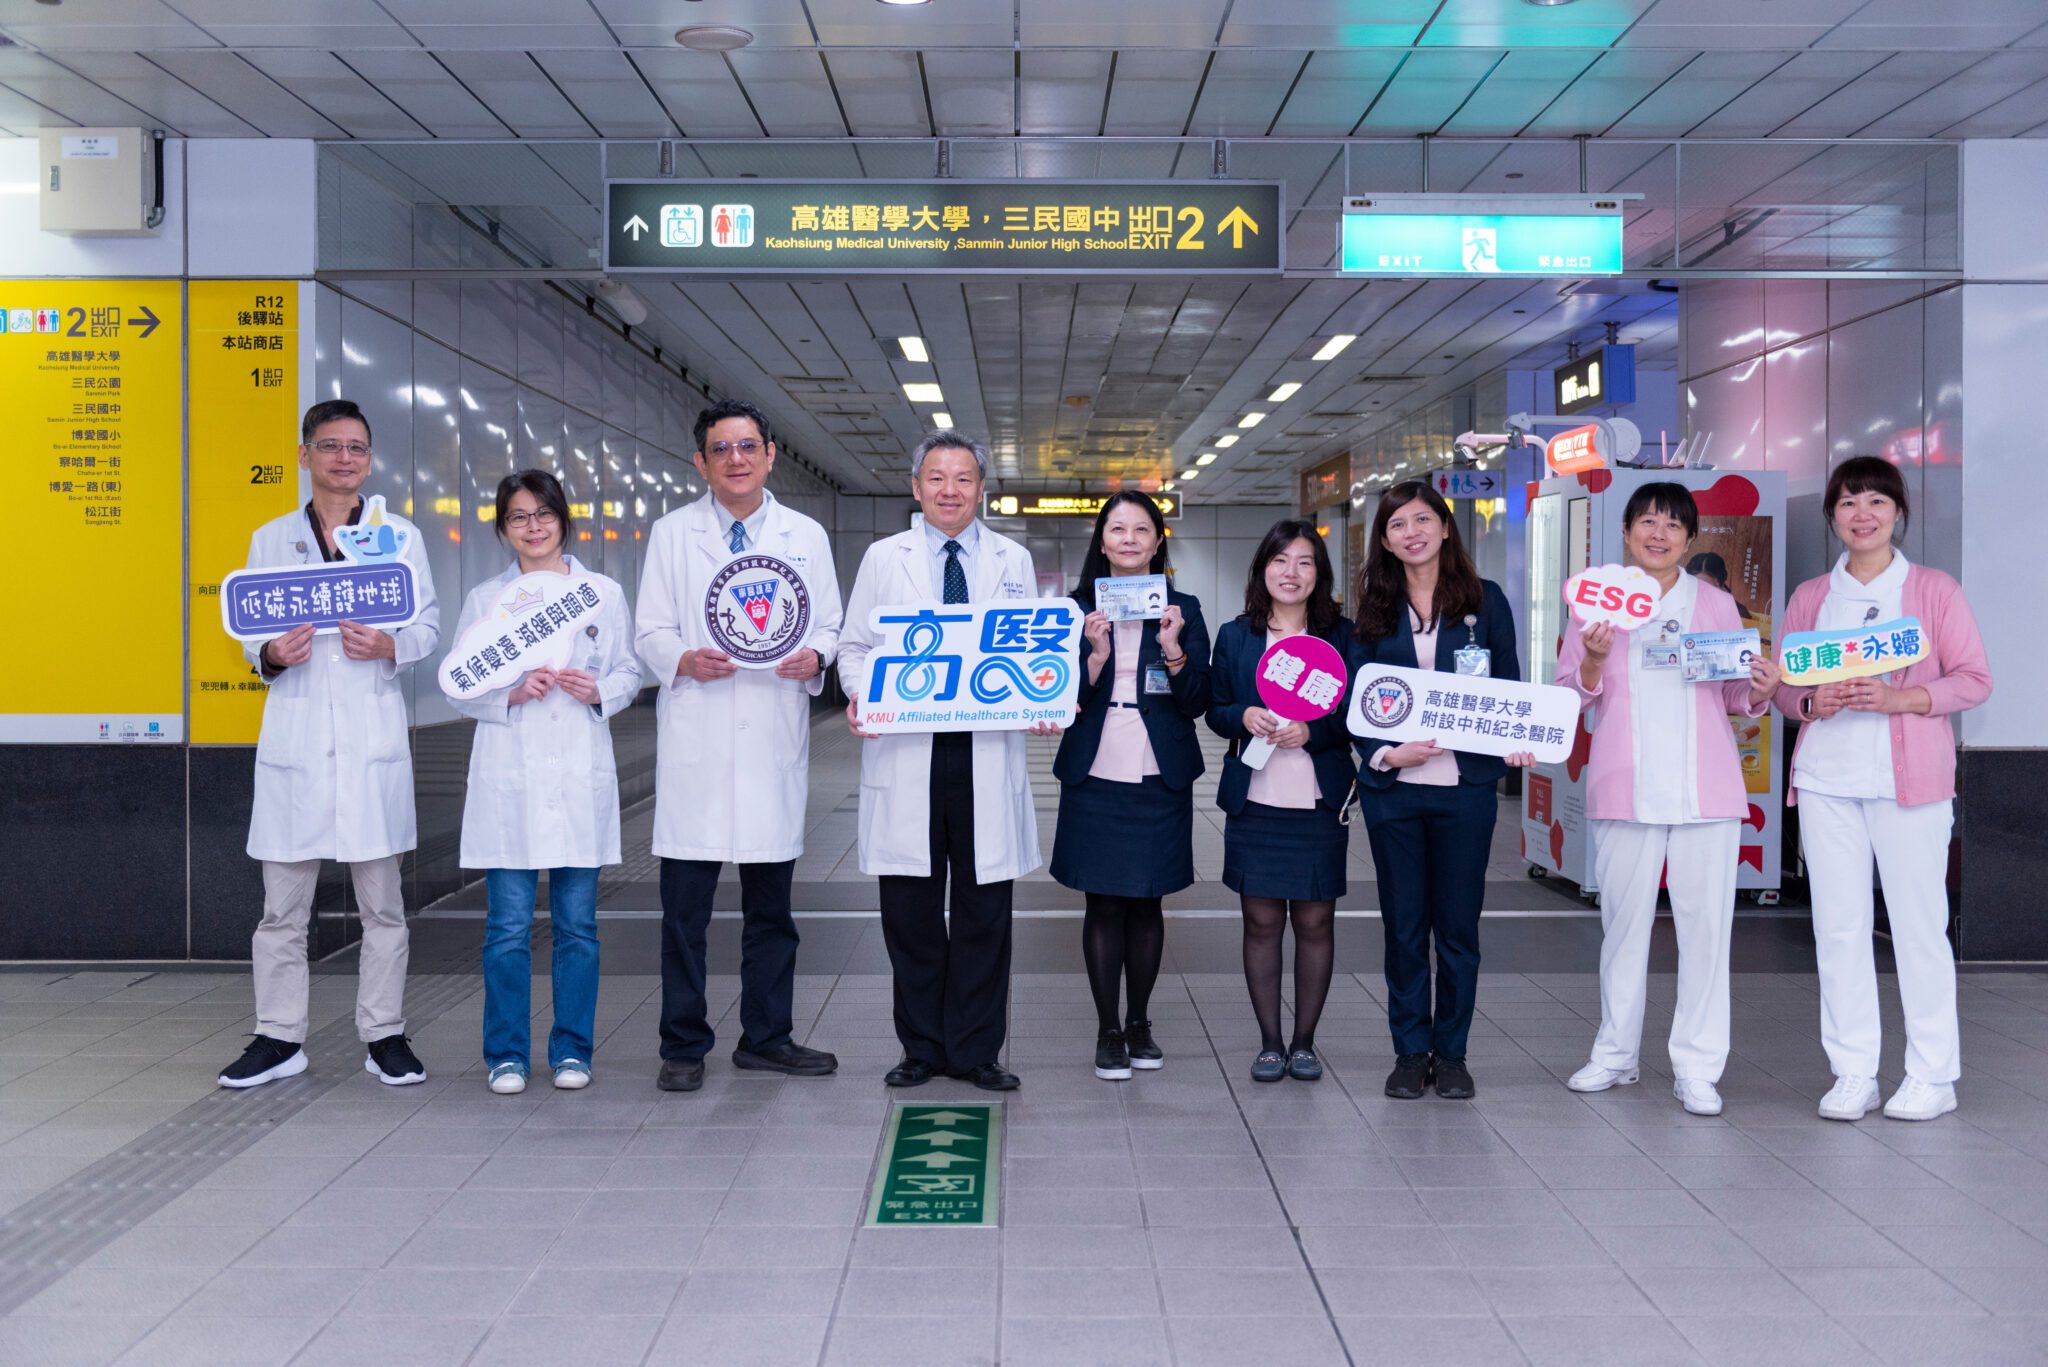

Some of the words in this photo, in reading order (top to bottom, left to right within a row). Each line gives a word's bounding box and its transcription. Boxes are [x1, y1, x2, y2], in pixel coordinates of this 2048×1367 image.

[1129, 206, 1173, 233] 出口
[1175, 206, 1205, 250] 2
[766, 237, 832, 251] Kaohsiung
[836, 237, 884, 249] Medical
[888, 237, 949, 251] University
[1008, 238, 1048, 250] Junior
[1051, 238, 1079, 252] High
[1084, 238, 1128, 250] School
[1129, 234, 1173, 250] EXIT
[1378, 256, 1422, 267] EXIT
[1538, 255, 1591, 268] 緊急出口
[255, 296, 284, 308] R12
[66, 307, 87, 337] 2
[91, 307, 121, 327] 出口
[237, 311, 284, 326] 後驛站
[91, 327, 120, 338] EXIT
[222, 335, 284, 350] 本站商店
[46, 351, 121, 361] 高雄醫學大學
[251, 368, 260, 387] 1
[263, 368, 284, 378] 出口
[72, 378, 121, 389] 三民公園
[263, 379, 283, 387] EXIT
[72, 403, 121, 414] 三民國中
[72, 430, 121, 440] 博愛國小
[251, 466, 263, 484] 2
[263, 465, 284, 475] 出口
[263, 476, 283, 484] EXIT
[85, 507, 121, 517] 松江街
[199, 586, 221, 595] 向日
[241, 576, 401, 619] 低碳永續護地球
[1575, 579, 1654, 618] ESG
[737, 649, 765, 659] MEDICAL
[1263, 649, 1343, 711] 健康
[238, 682, 271, 691] 幸福時
[1424, 690, 1532, 717] 高雄醫學大學
[866, 712, 895, 724] KMU
[898, 710, 951, 723] Affiliated
[954, 709, 1018, 721] Healthcare
[1022, 708, 1066, 722] System
[1421, 710, 1566, 745] 附設中和紀念醫院
[886, 1201, 977, 1209] 緊急出口
[894, 1212, 966, 1220] EXIT
